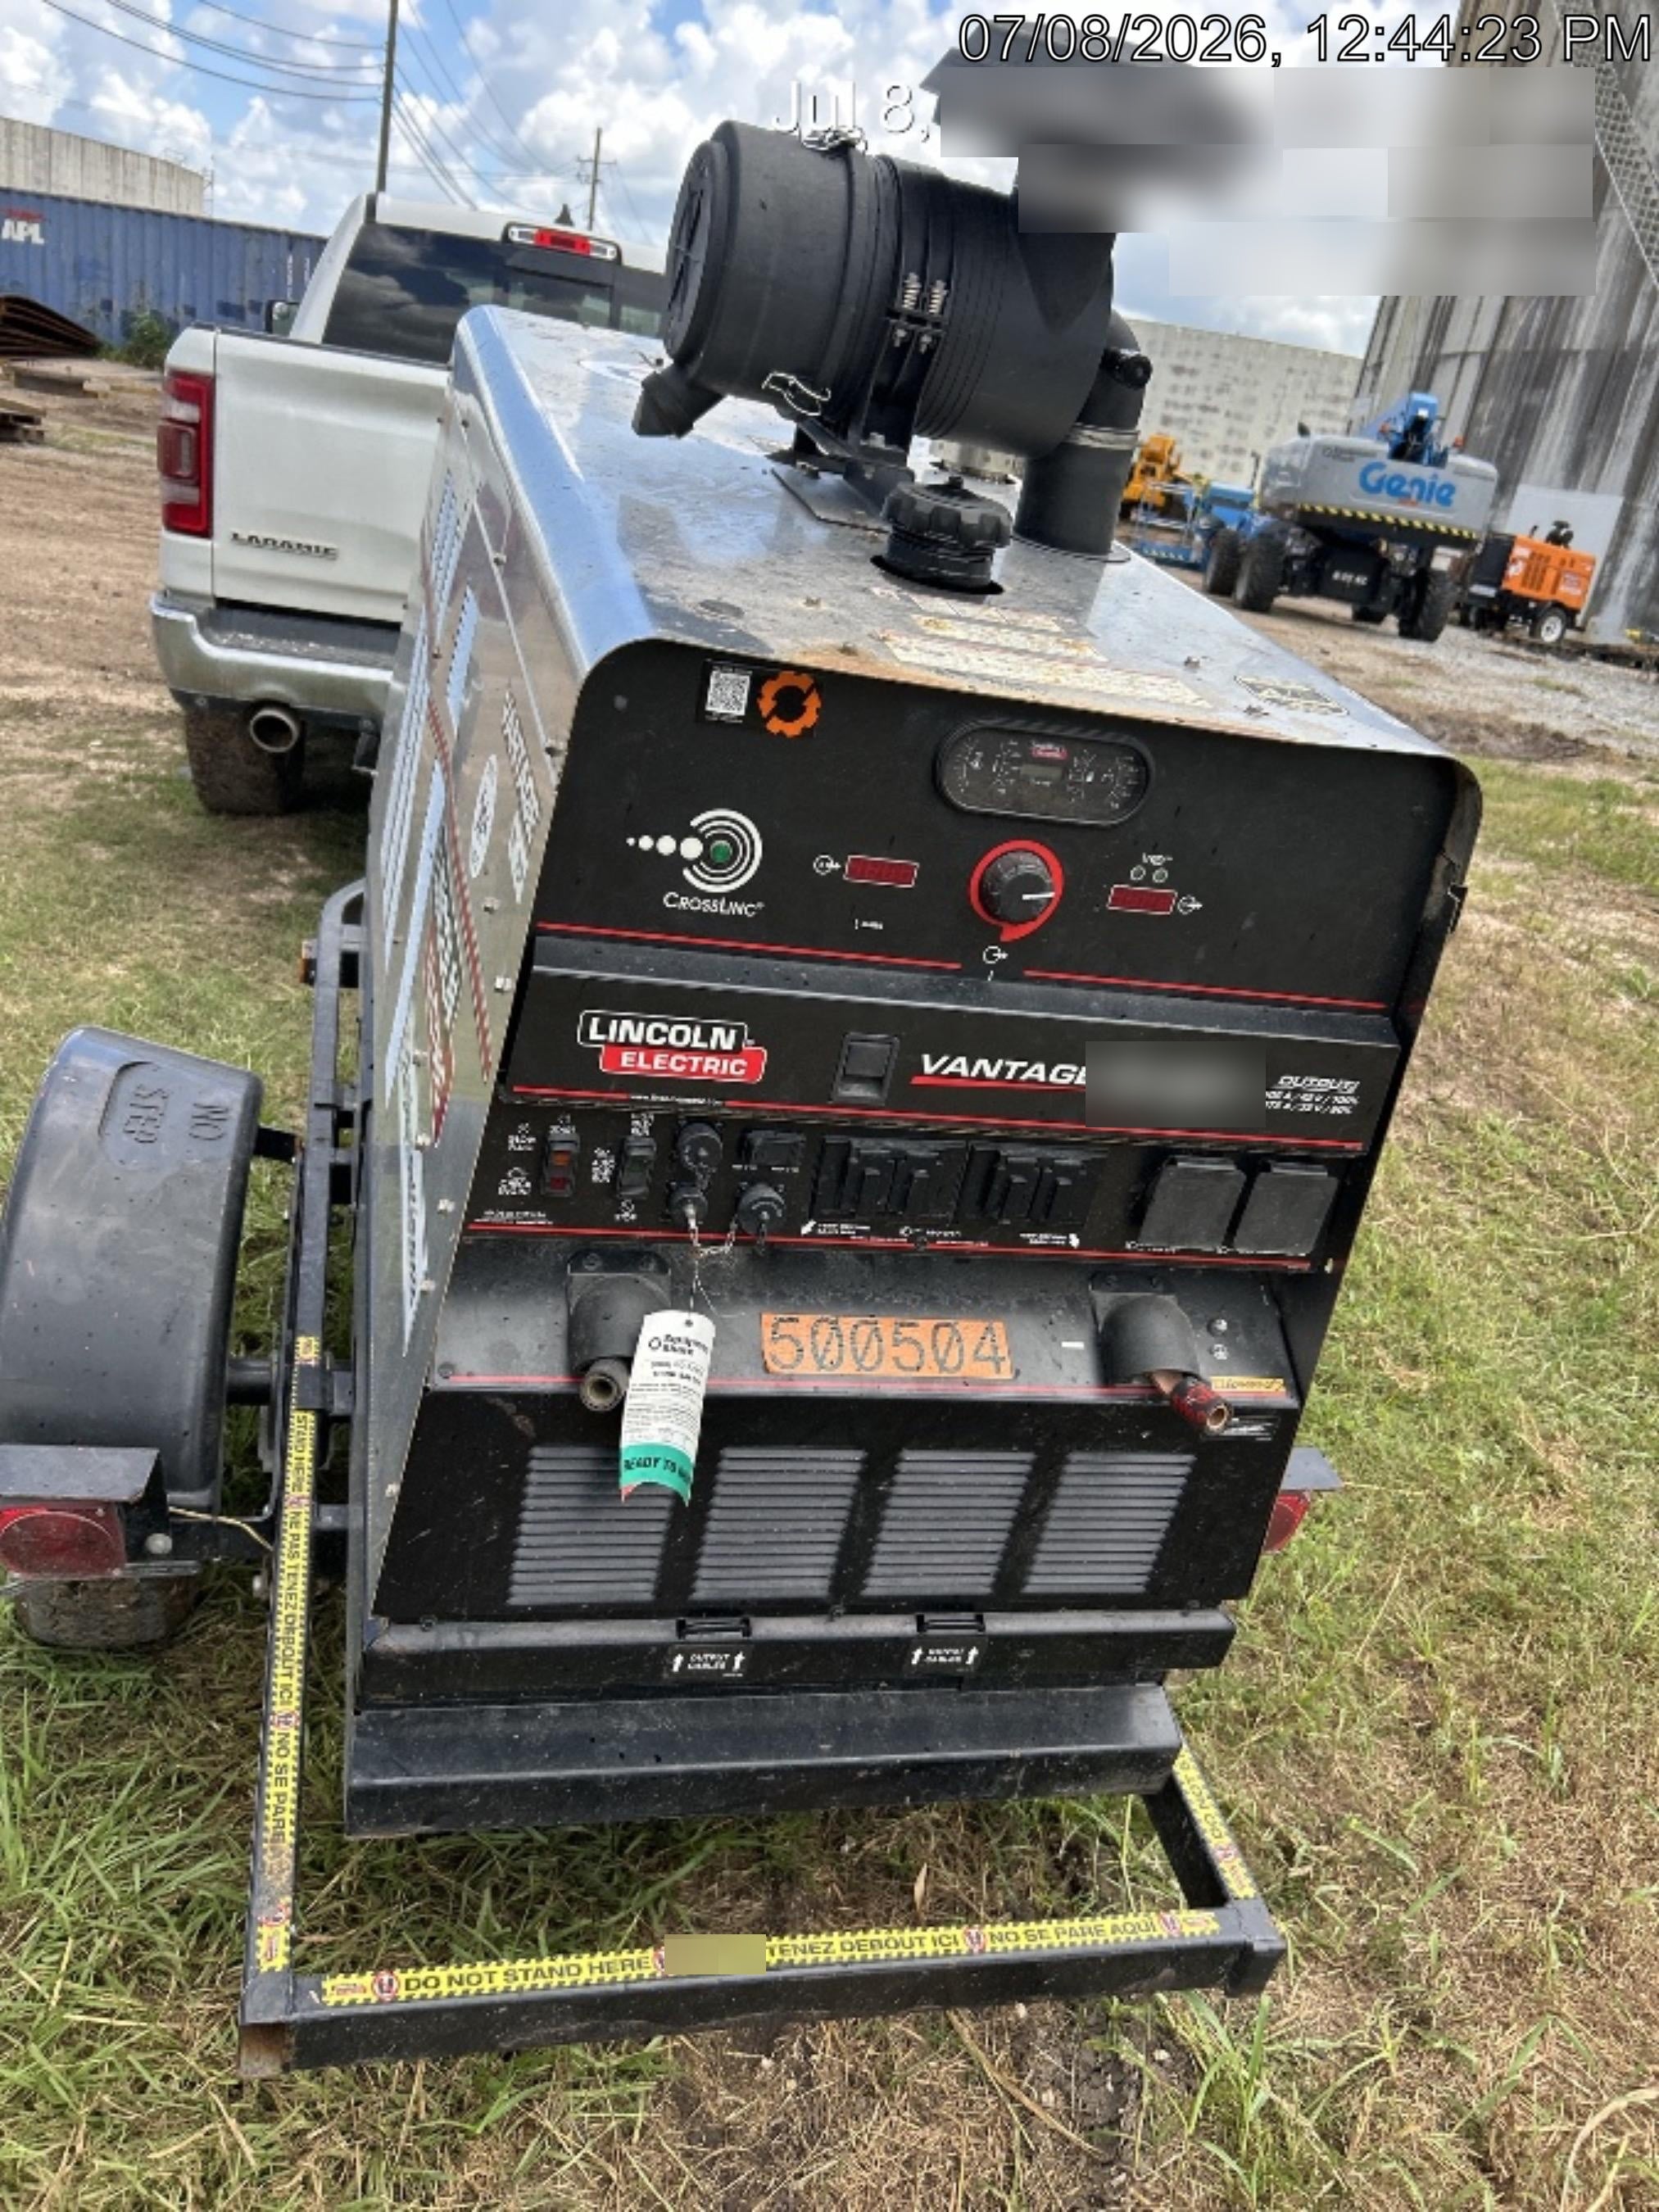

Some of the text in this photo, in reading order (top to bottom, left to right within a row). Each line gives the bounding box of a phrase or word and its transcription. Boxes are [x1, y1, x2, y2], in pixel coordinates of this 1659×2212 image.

[2, 218, 44, 244] APL
[1358, 460, 1457, 508] Genie
[588, 1017, 737, 1050] LINCOLN
[620, 1051, 748, 1077] ELECTRIC
[124, 1083, 169, 1143] STEP
[188, 1102, 229, 1140] NO
[770, 1315, 1007, 1376] 500504
[294, 1414, 309, 1457] STAND
[292, 1457, 306, 1492] HERE
[623, 1455, 660, 1471] READY
[288, 1534, 301, 1560] PAS
[284, 1564, 300, 1612] TENEZ
[279, 1615, 297, 1676] DEBOUT
[279, 1679, 293, 1707] ICI
[274, 1733, 289, 1758] NO
[274, 1766, 288, 1788] SE
[272, 1793, 288, 1844] PARE
[768, 1940, 835, 1957] TENEZ
[840, 1935, 926, 1953] DEBOUT
[932, 1933, 959, 1948] ICI
[990, 1931, 1021, 1944] NO
[1024, 1928, 1051, 1942] SE
[1054, 1923, 1106, 1941] PARE
[404, 1956, 650, 1992] DO NOT STAND HERE
